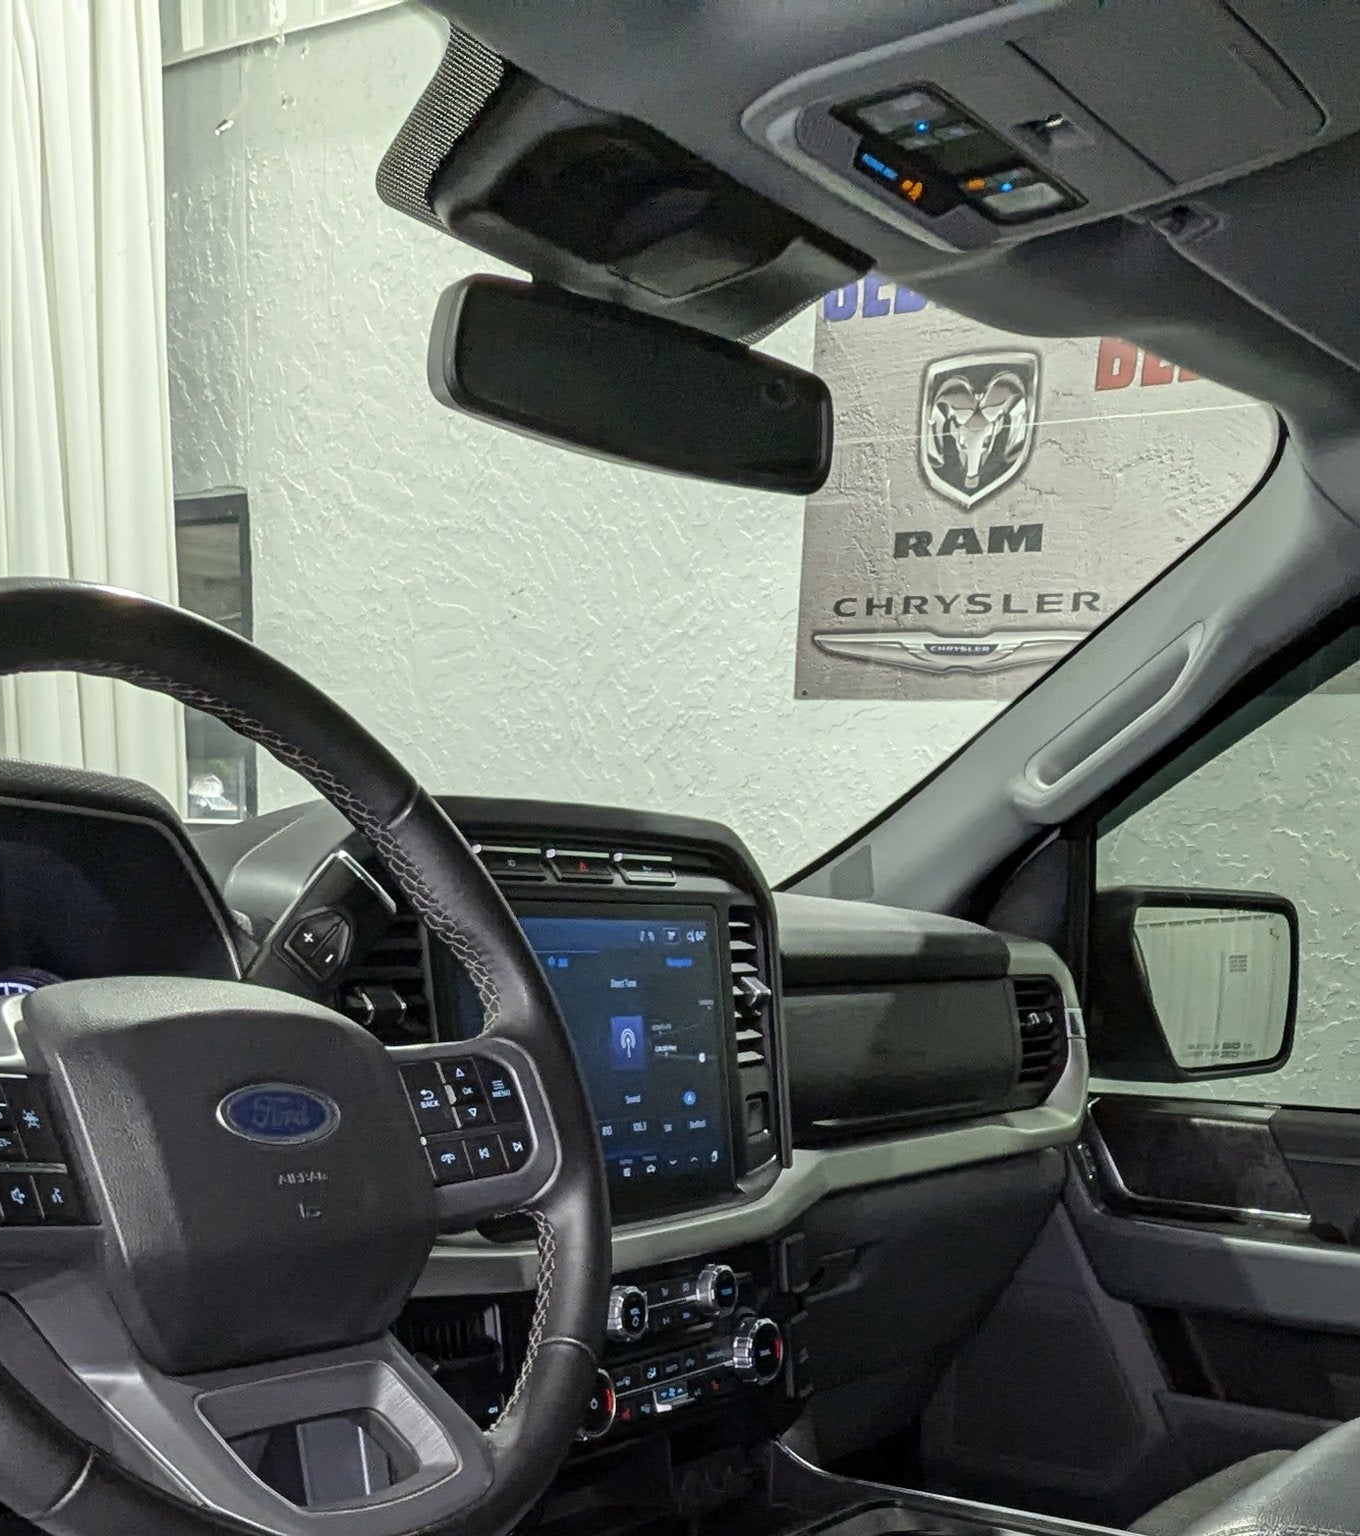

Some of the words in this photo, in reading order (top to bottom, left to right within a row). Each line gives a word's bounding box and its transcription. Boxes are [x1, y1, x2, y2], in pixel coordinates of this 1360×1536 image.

[893, 523, 1044, 559] RAM
[833, 592, 1101, 618] CHRYSLER
[929, 644, 992, 654] CHRYSLER
[492, 1090, 511, 1098] MENU
[421, 1100, 440, 1109] BACK
